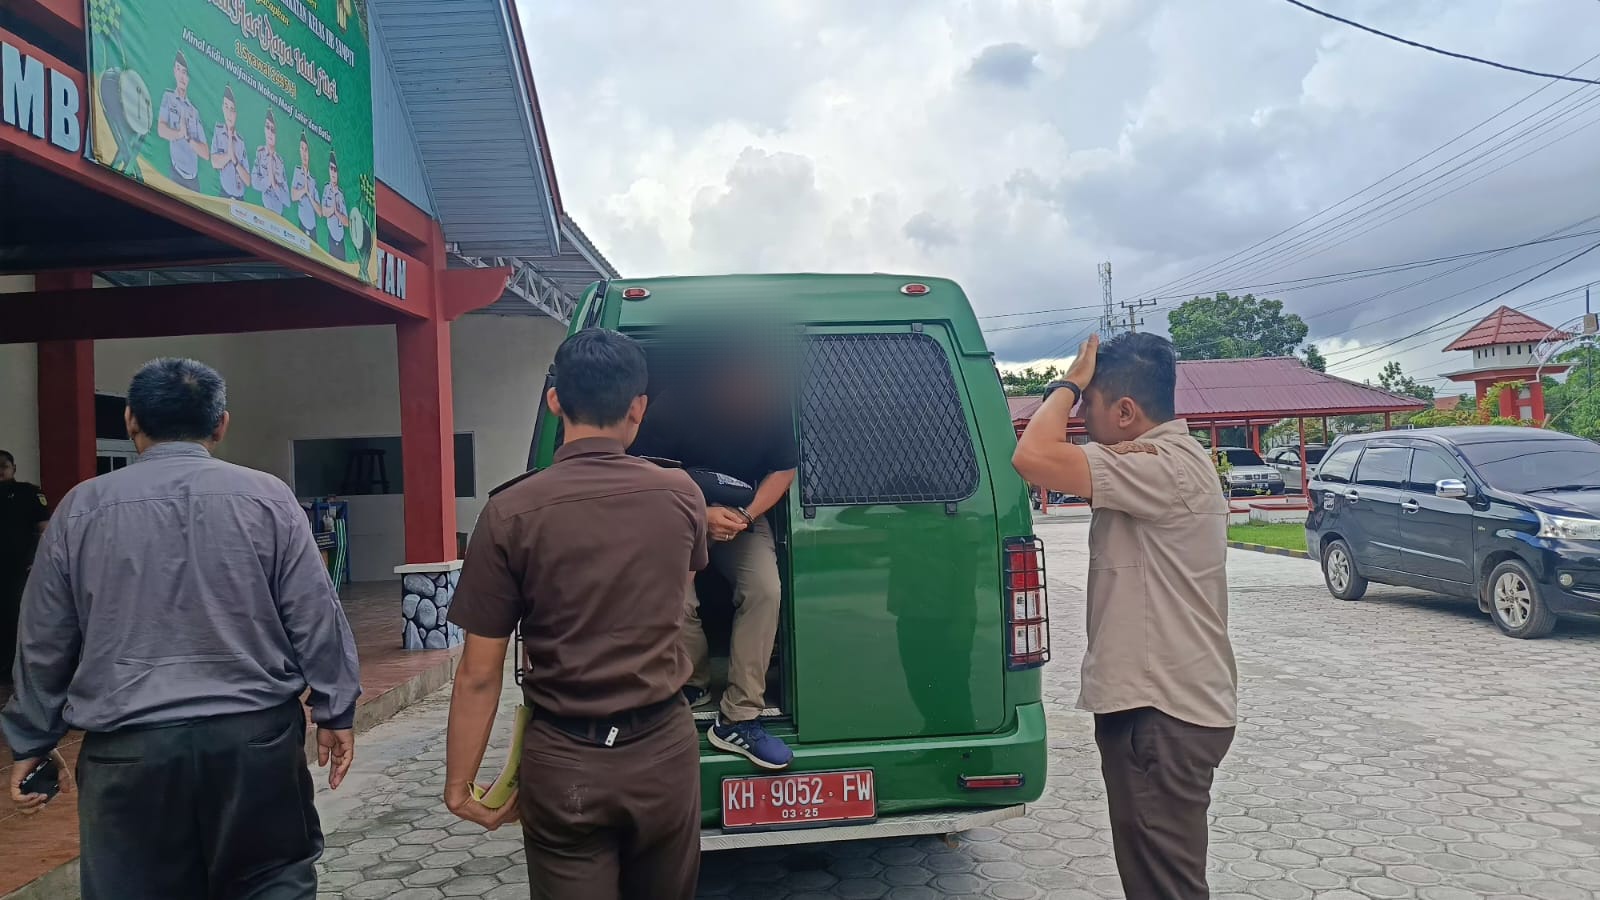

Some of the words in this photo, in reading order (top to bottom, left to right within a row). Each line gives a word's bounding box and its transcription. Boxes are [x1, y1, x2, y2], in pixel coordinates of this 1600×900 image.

[182, 27, 206, 52] Minal
[205, 44, 225, 66] Aidin
[257, 81, 278, 104] Mohon
[241, 43, 271, 80] Syawal
[260, 13, 294, 67] Raya
[308, 10, 325, 42] KELAS
[335, 37, 355, 67] SAMPIT
[728, 782, 755, 810] KH
[770, 777, 824, 807] 9052
[843, 773, 871, 802] FW
